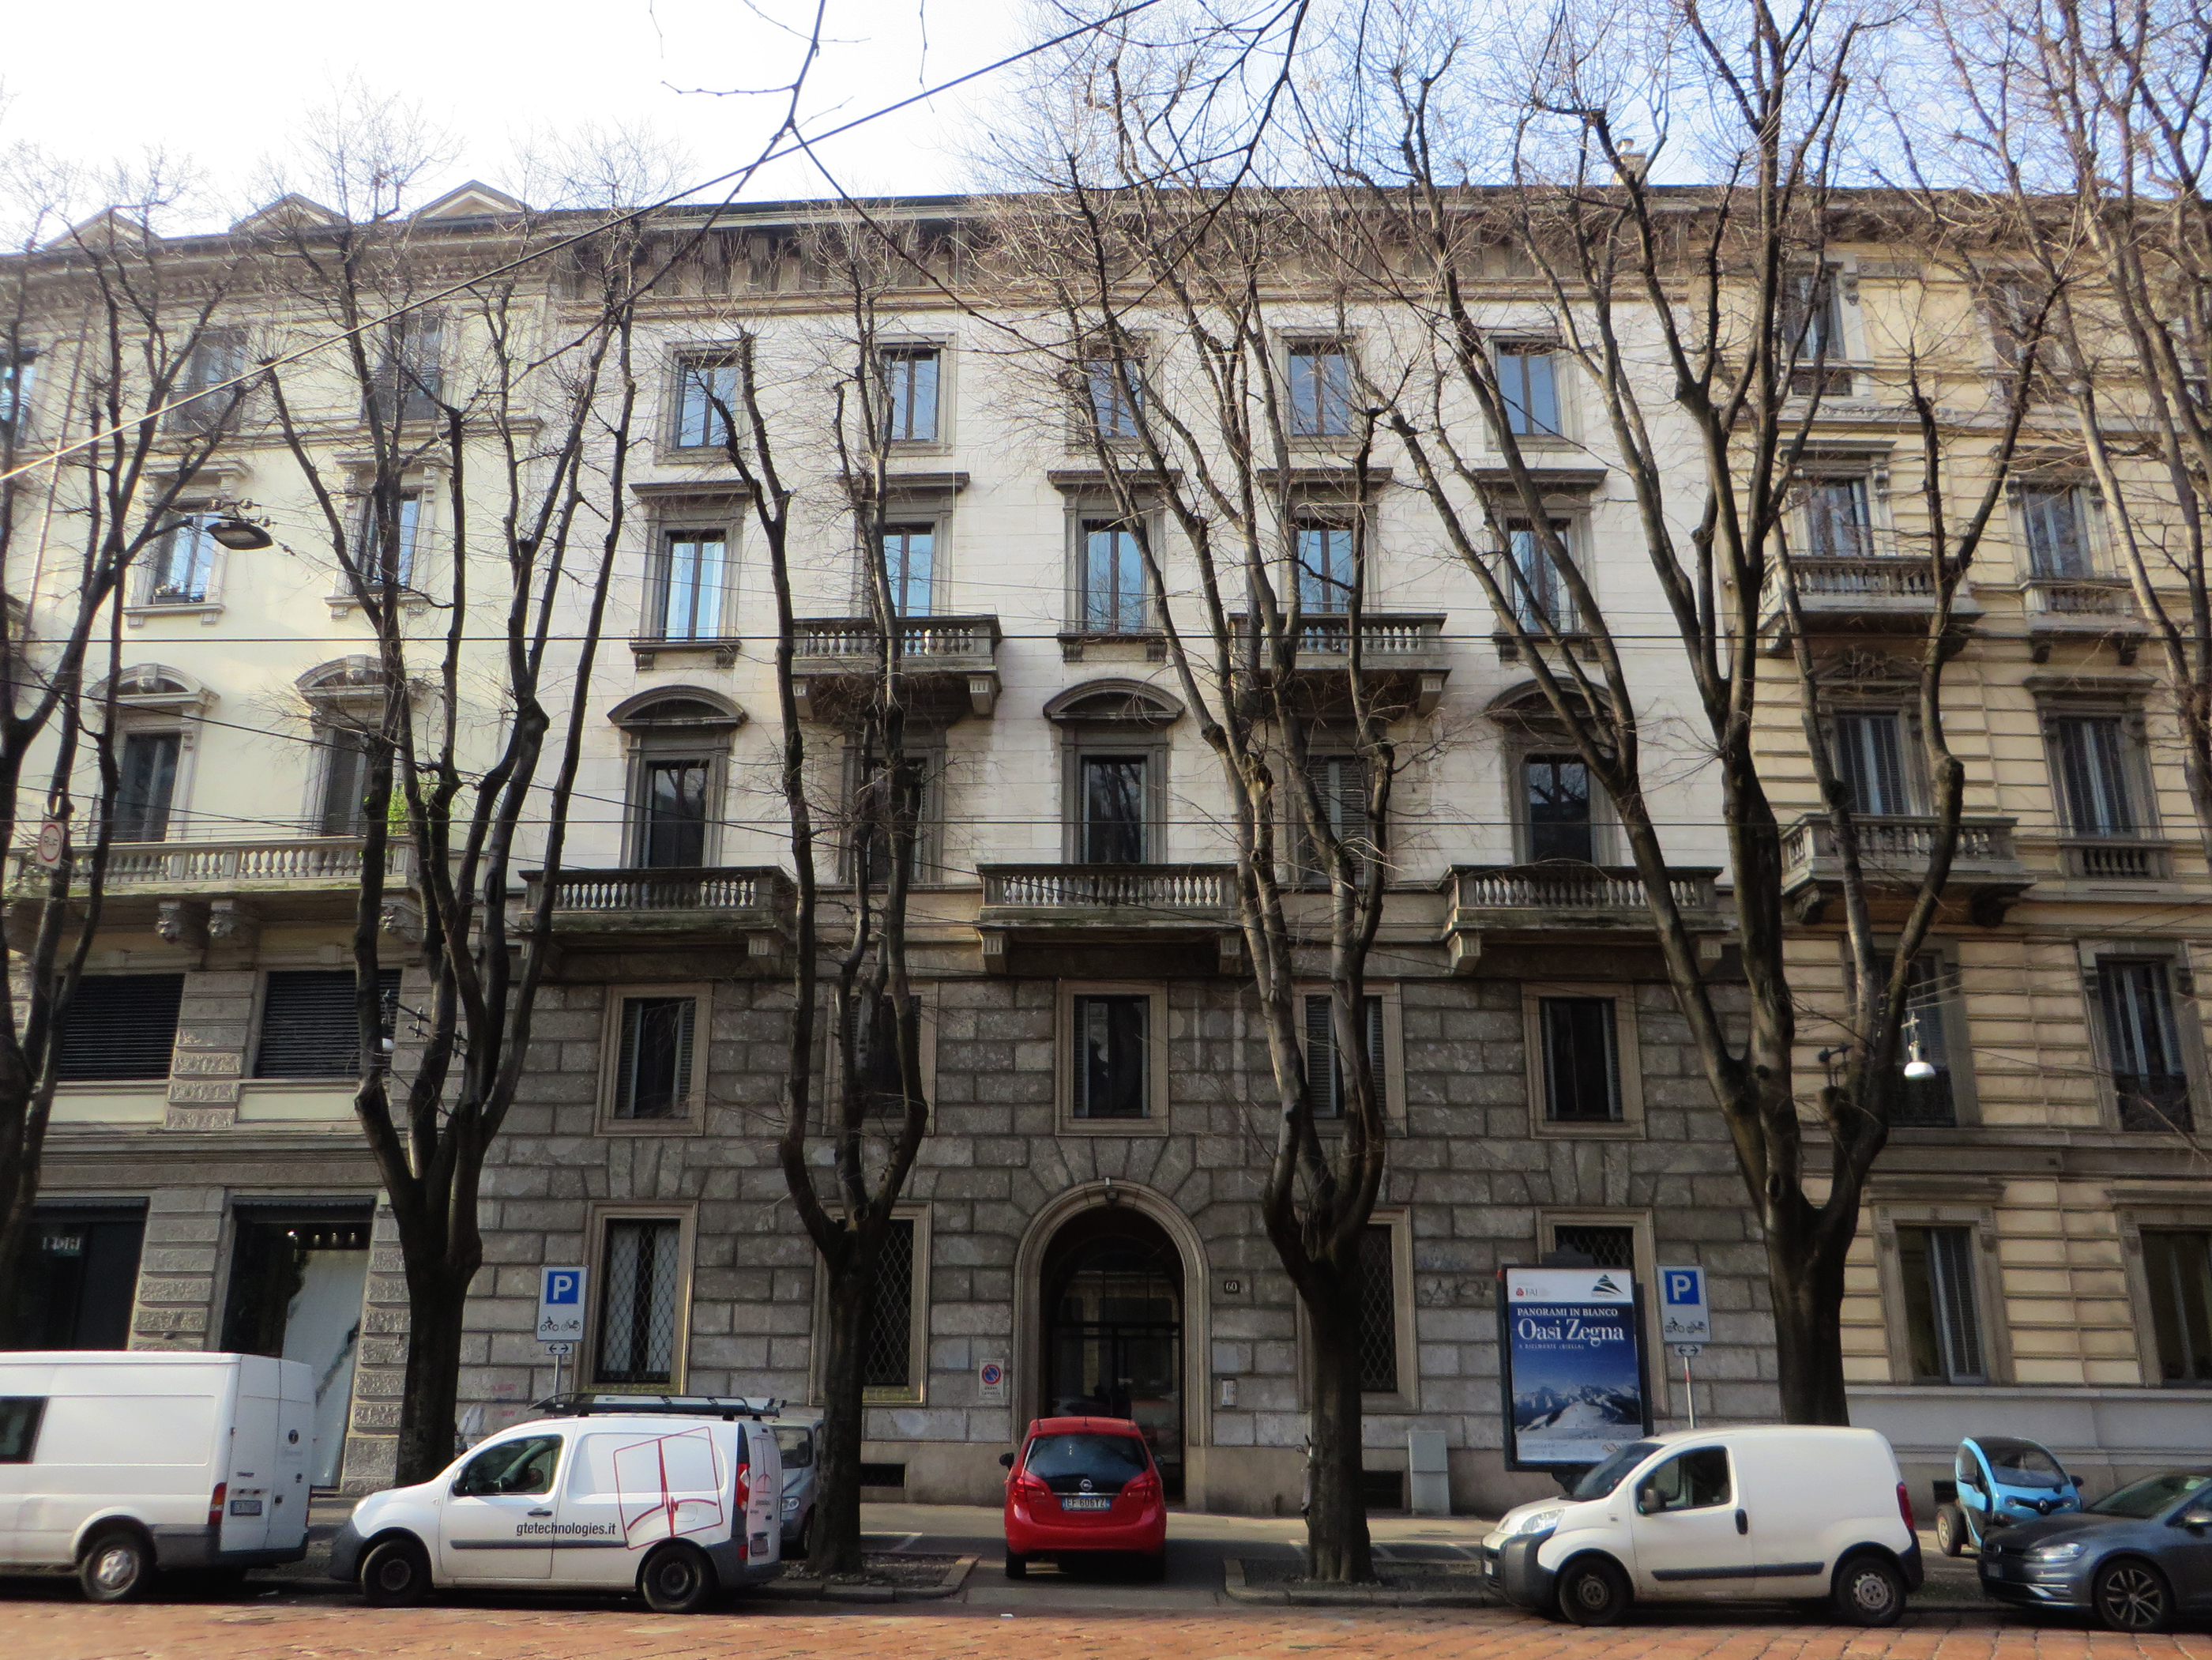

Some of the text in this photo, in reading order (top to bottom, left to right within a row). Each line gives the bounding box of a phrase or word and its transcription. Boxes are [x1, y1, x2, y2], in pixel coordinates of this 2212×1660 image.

[553, 1274, 573, 1301] P
[1225, 1282, 1238, 1291] 60
[1672, 1274, 1692, 1301] P
[1517, 1308, 1619, 1317] PANORAMI IN BIANCO
[1518, 1318, 1625, 1347] Oasi Zegna
[516, 1522, 616, 1537] gtetechnologies.it
